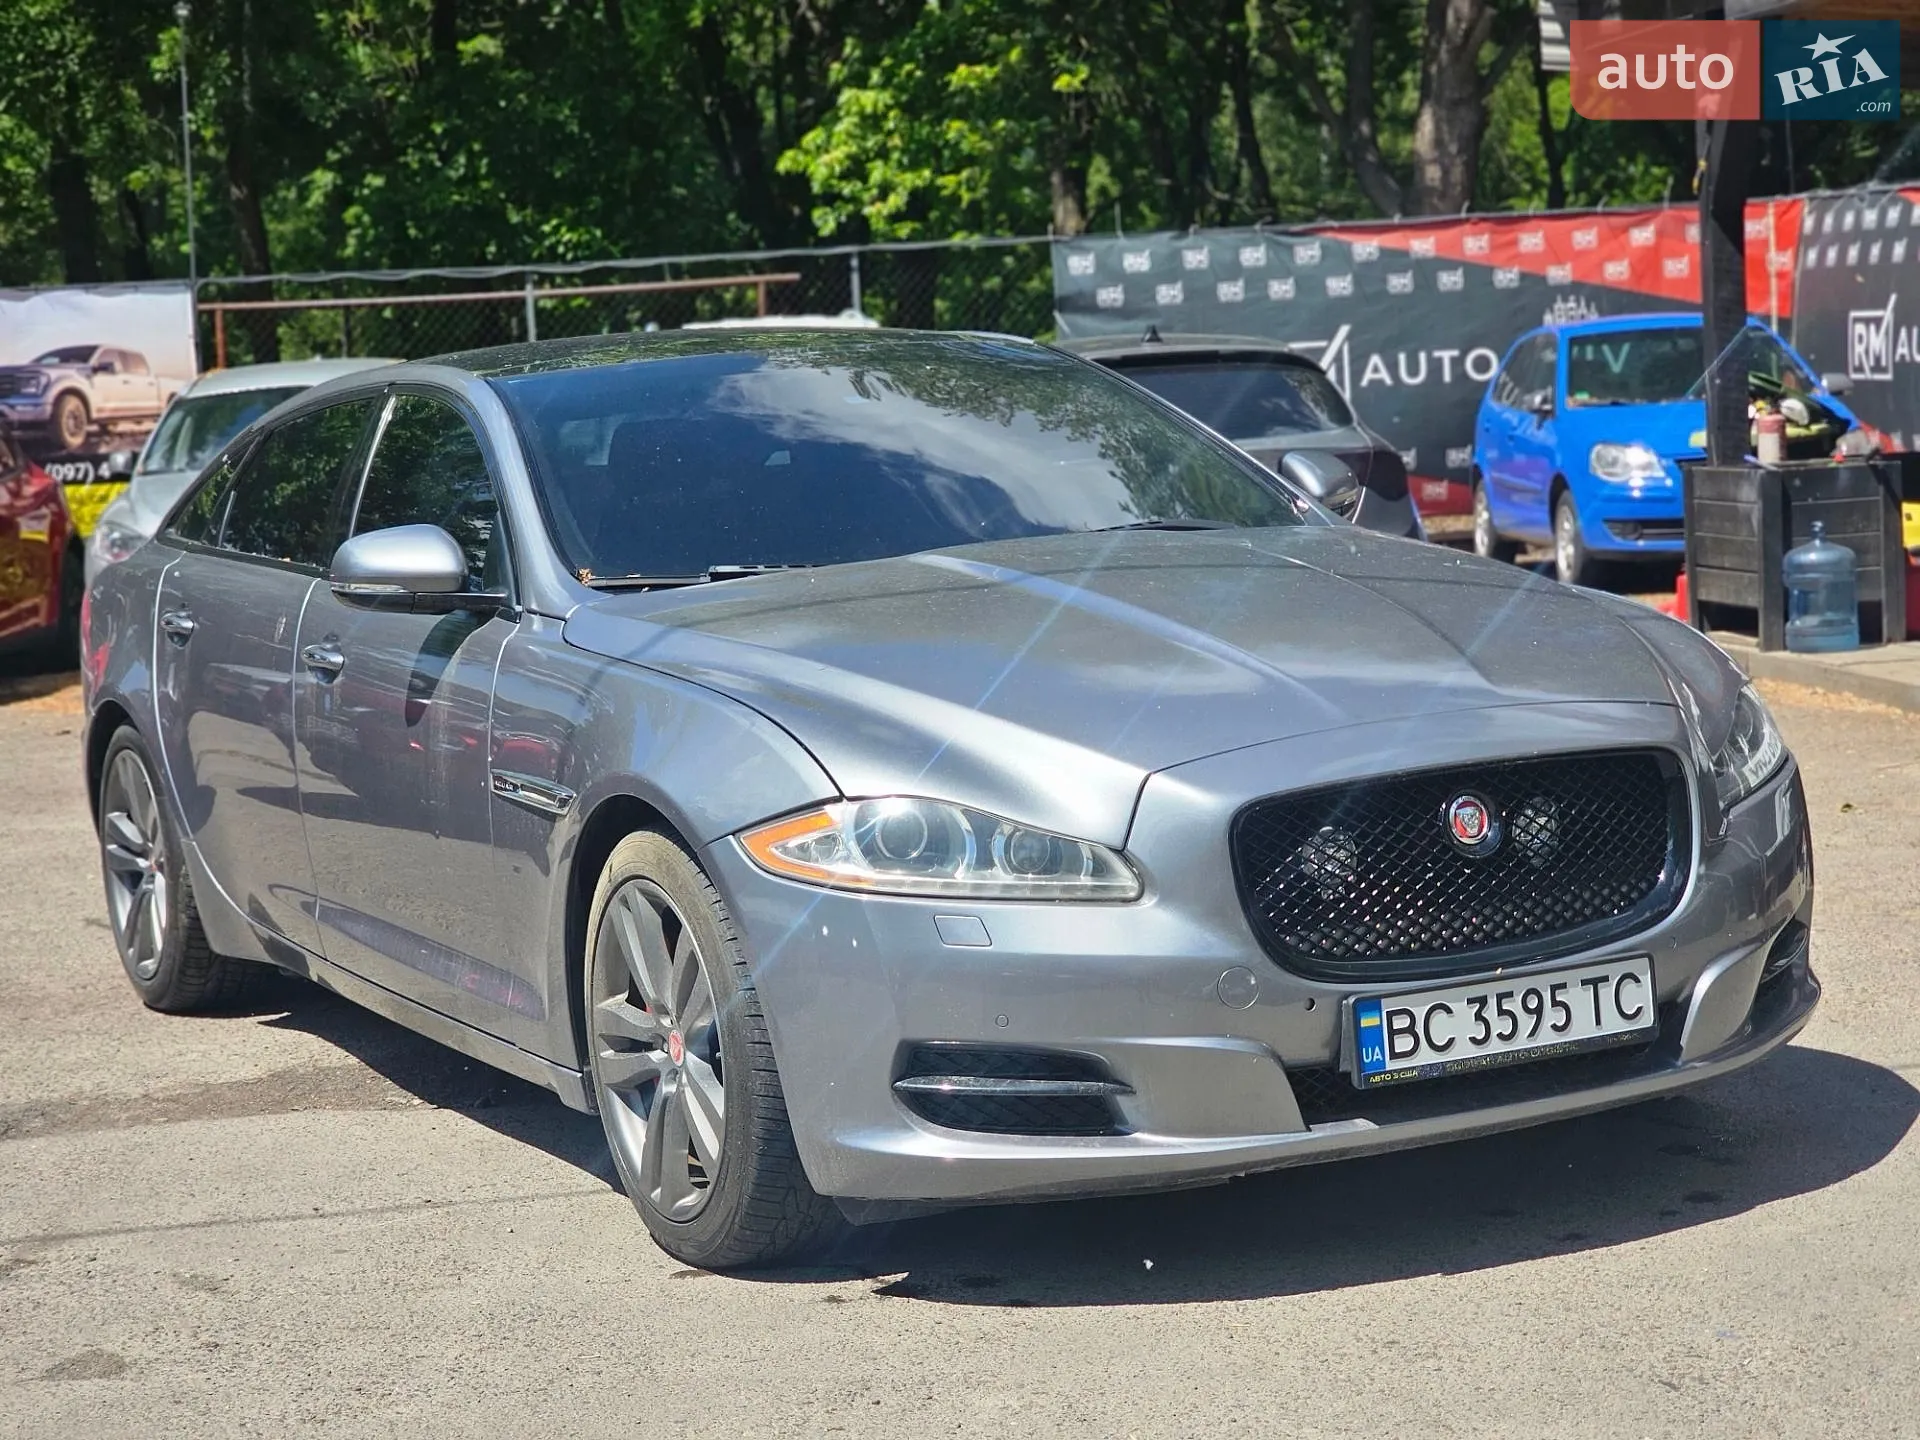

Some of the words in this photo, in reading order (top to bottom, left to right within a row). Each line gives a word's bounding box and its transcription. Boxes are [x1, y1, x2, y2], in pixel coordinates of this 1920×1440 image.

[1852, 308, 1892, 378] RM
[1360, 347, 1499, 387] AUTO
[45, 461, 94, 484] (097)
[1386, 1002, 1456, 1060] BC
[1467, 982, 1572, 1046] 3595
[1580, 972, 1642, 1027] TC
[1362, 1046, 1383, 1063] UA
[1369, 1072, 1391, 1083] АВТО
